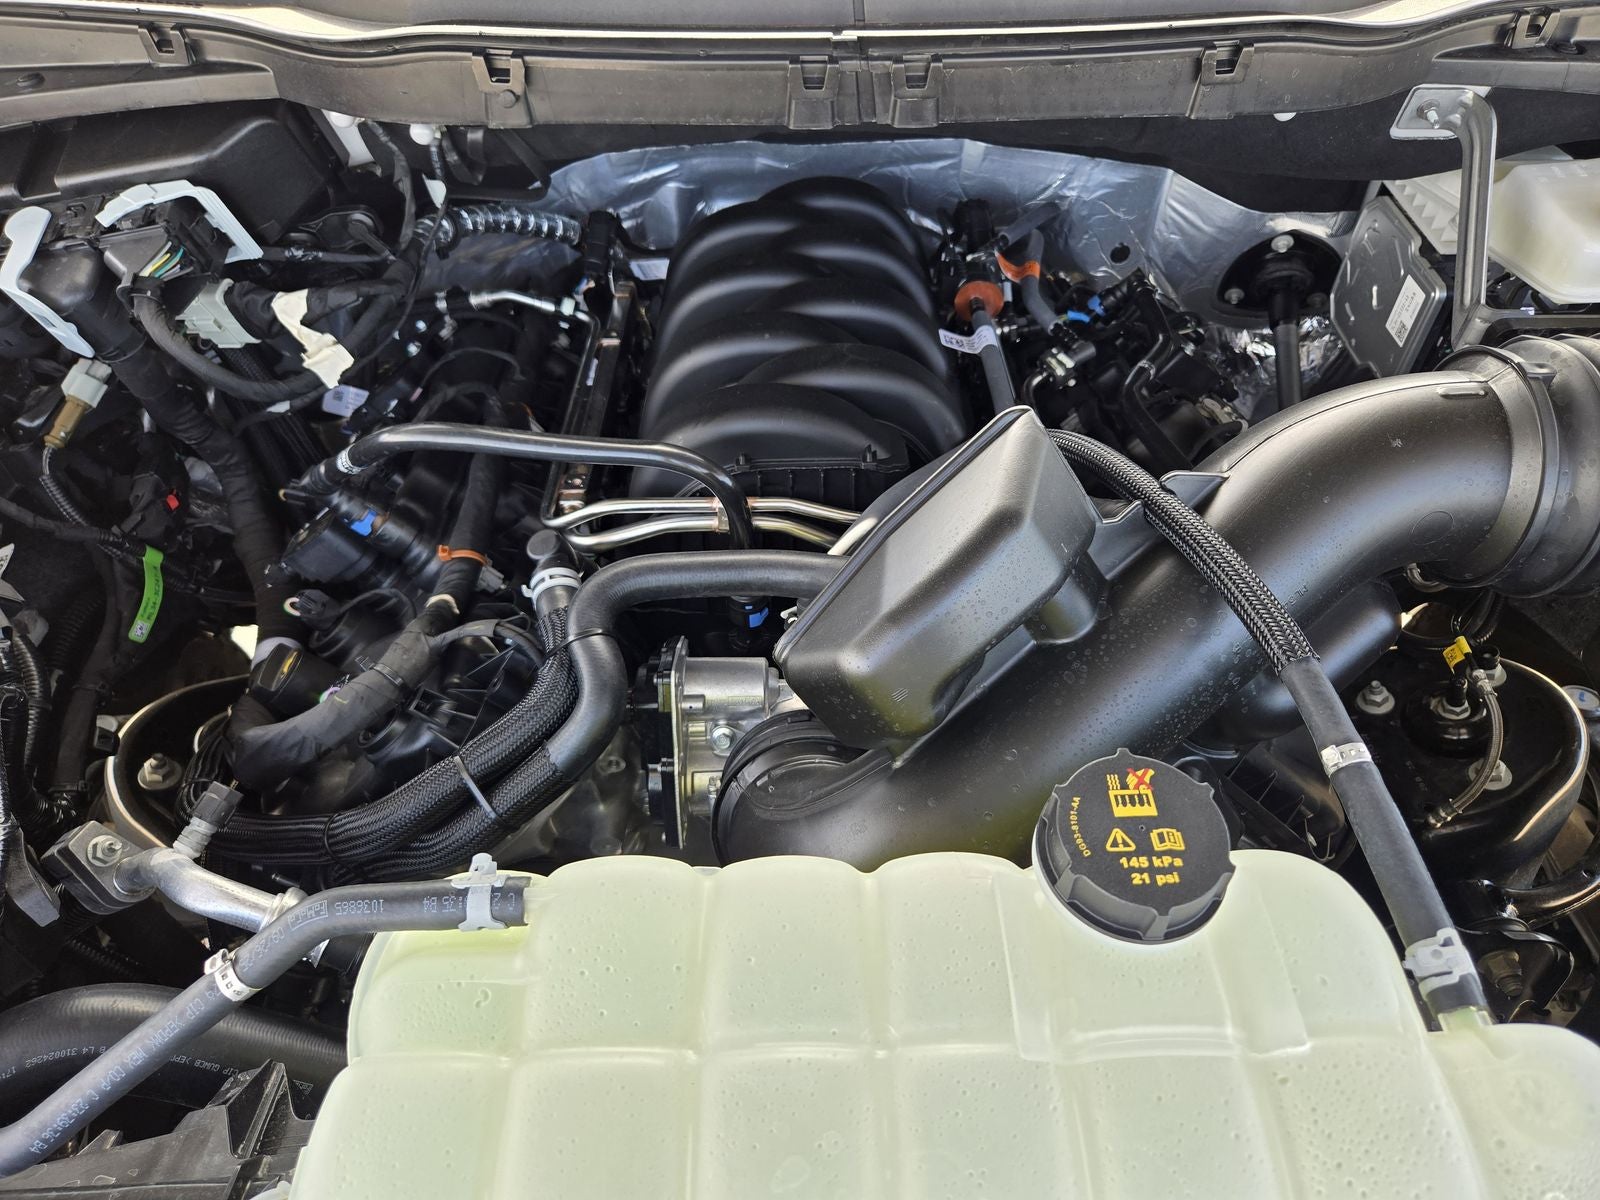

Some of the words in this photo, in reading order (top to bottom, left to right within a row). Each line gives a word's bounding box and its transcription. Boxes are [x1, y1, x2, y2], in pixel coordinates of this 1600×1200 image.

[1119, 857, 1149, 869] 145
[1152, 856, 1184, 868] kPa
[1131, 873, 1150, 885] 21
[1156, 872, 1180, 886] psi
[334, 898, 384, 915] 1036865
